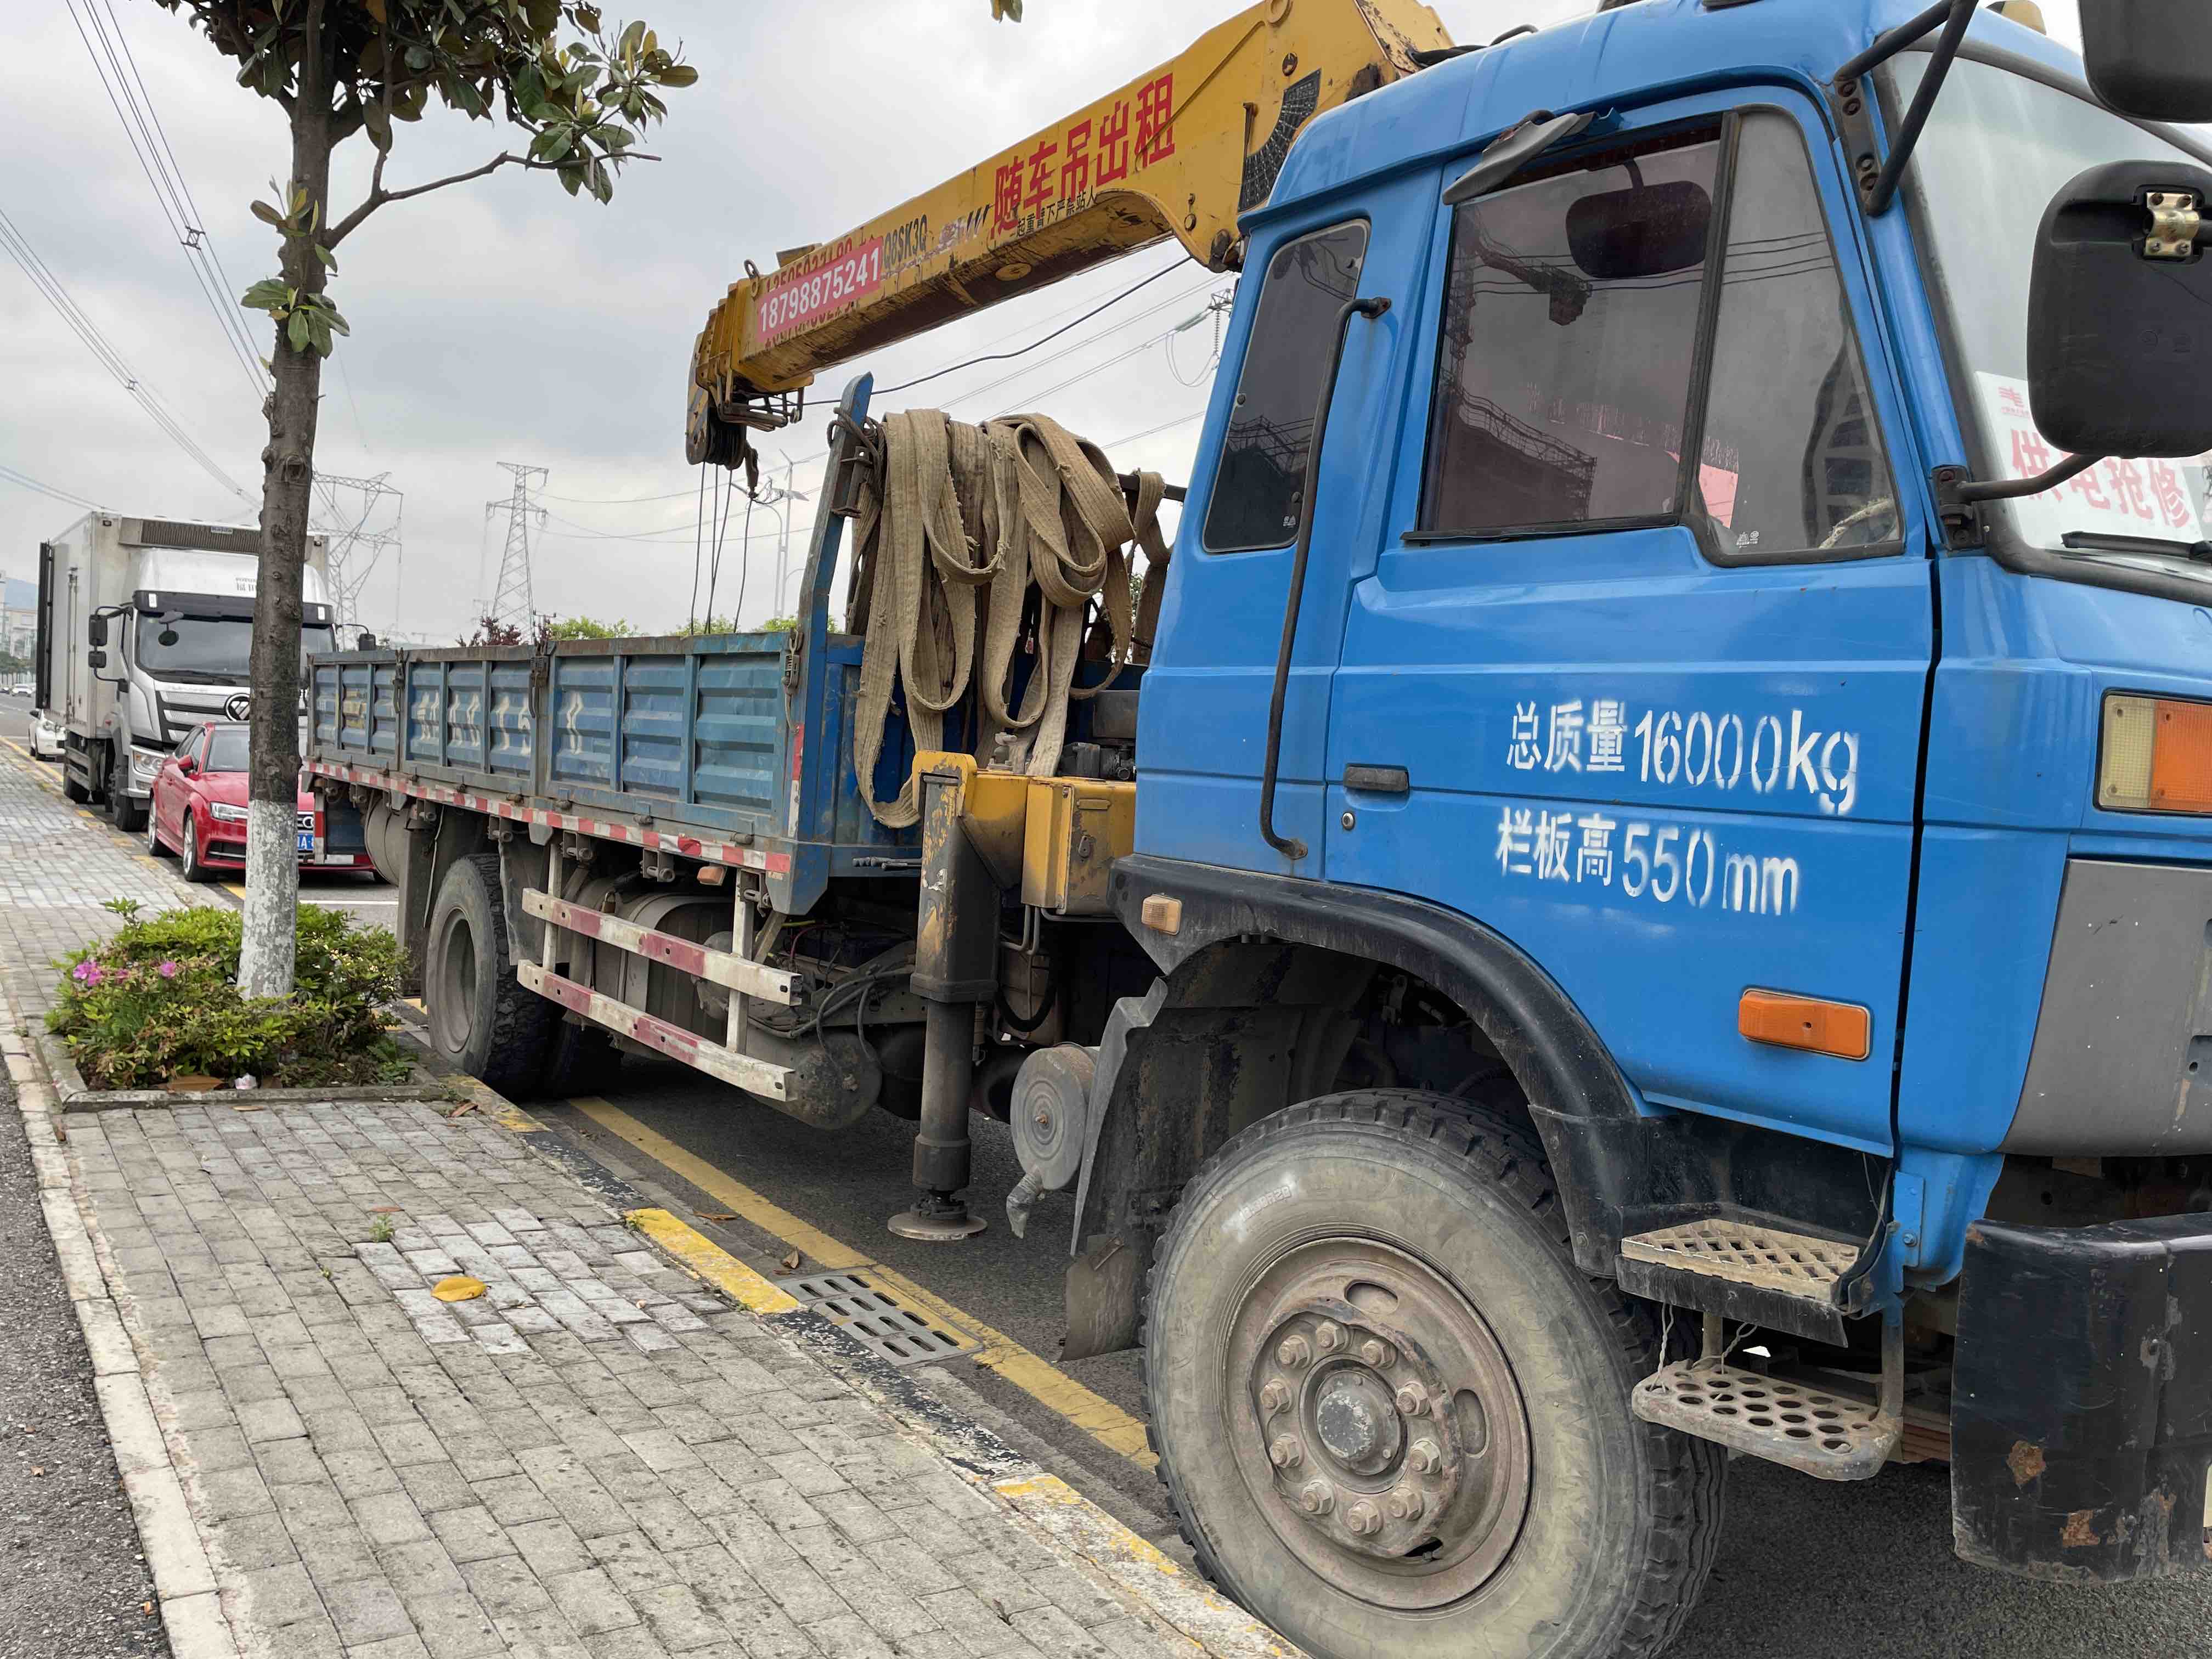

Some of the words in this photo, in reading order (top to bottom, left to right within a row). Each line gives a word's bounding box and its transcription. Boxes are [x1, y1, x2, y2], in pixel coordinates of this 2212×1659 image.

[989, 72, 1176, 240] 随车吊出租
[760, 246, 880, 332] 18798875241
